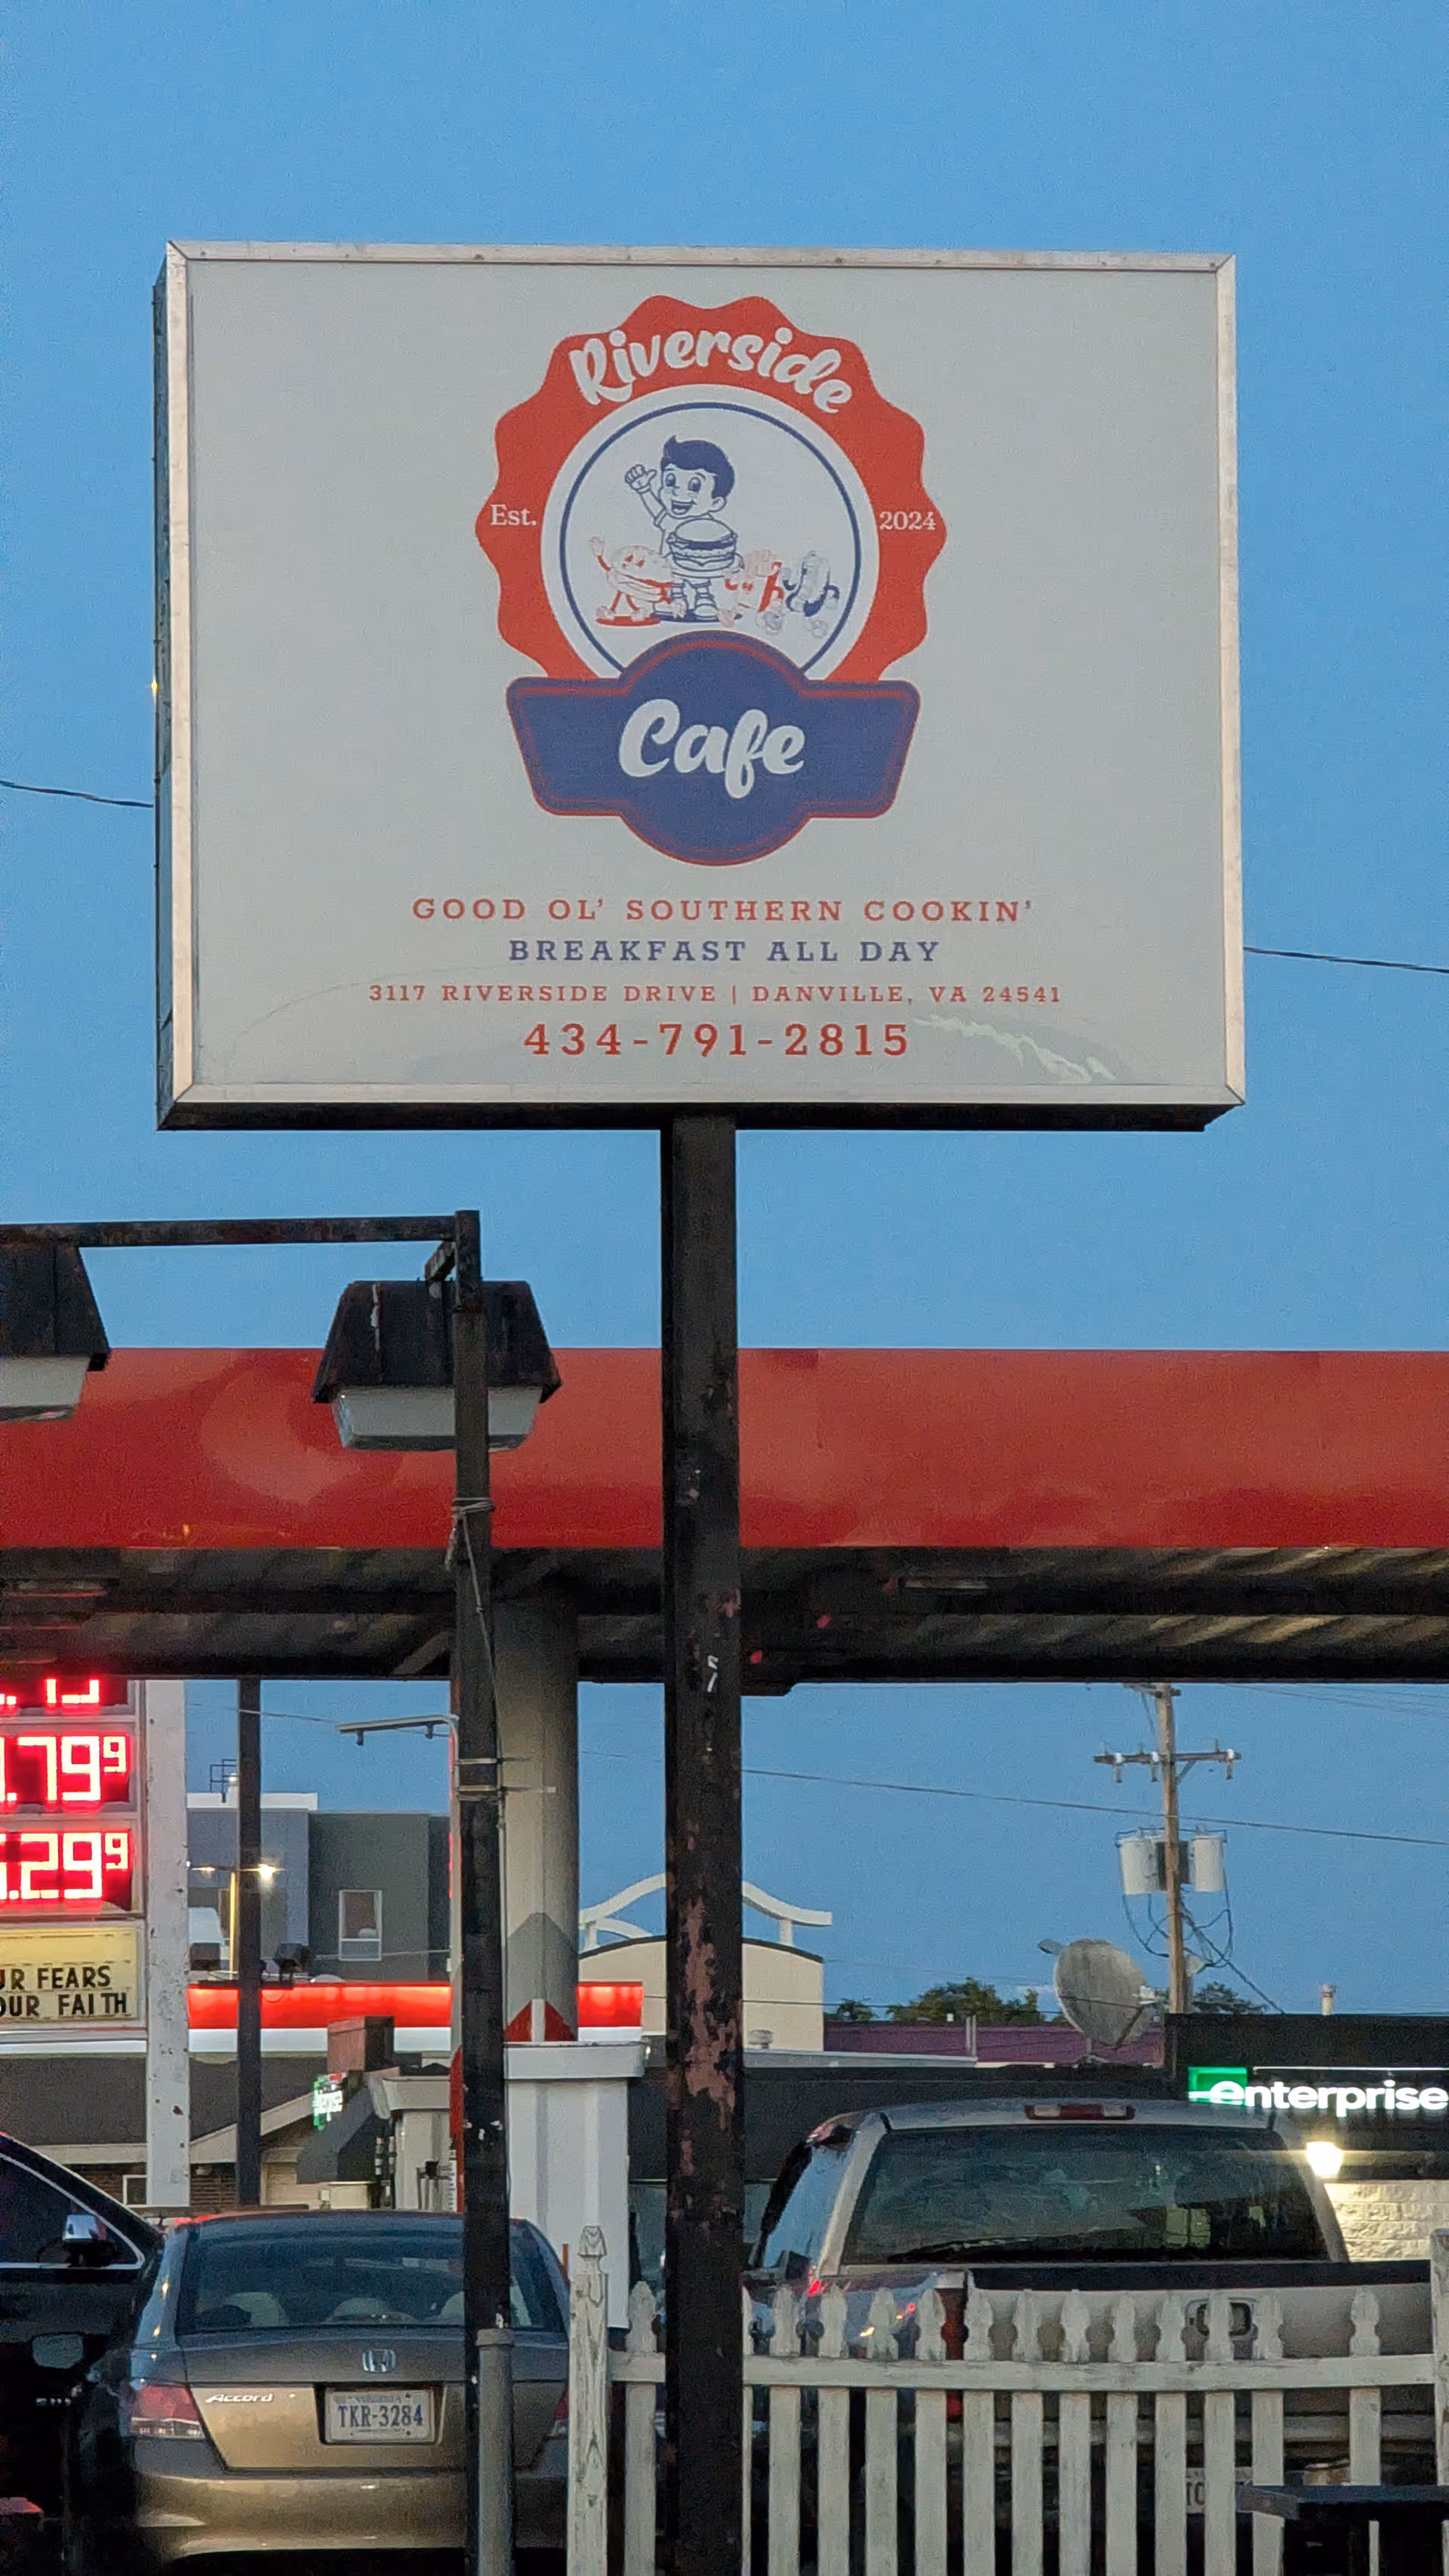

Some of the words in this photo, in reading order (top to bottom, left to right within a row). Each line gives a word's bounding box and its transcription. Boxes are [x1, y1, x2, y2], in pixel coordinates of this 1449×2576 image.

[568, 327, 852, 414] Riverside
[490, 504, 537, 527] Est.
[879, 511, 937, 531] 2024
[620, 699, 806, 799] Cafe
[412, 899, 526, 919] GOOD
[626, 900, 841, 922] SOUTHERN
[509, 940, 745, 962] BREAKFAST
[768, 941, 838, 962] ALL
[860, 941, 940, 962] DAY
[370, 986, 425, 1002] 3117
[443, 986, 608, 1002] RIVERSIDE
[624, 986, 715, 1002] DRIVE
[752, 986, 912, 1005] DANVILLE,
[930, 986, 967, 1003] VA
[983, 987, 1060, 1003] 24541
[524, 1023, 908, 1057] 434-791-2815
[38, 1965, 111, 1989] FEARS
[58, 1993, 127, 2015] FAITH
[1209, 2079, 1448, 2117] enterprise
[205, 2393, 273, 2402] Accord
[338, 2405, 424, 2428] TKR-3284
